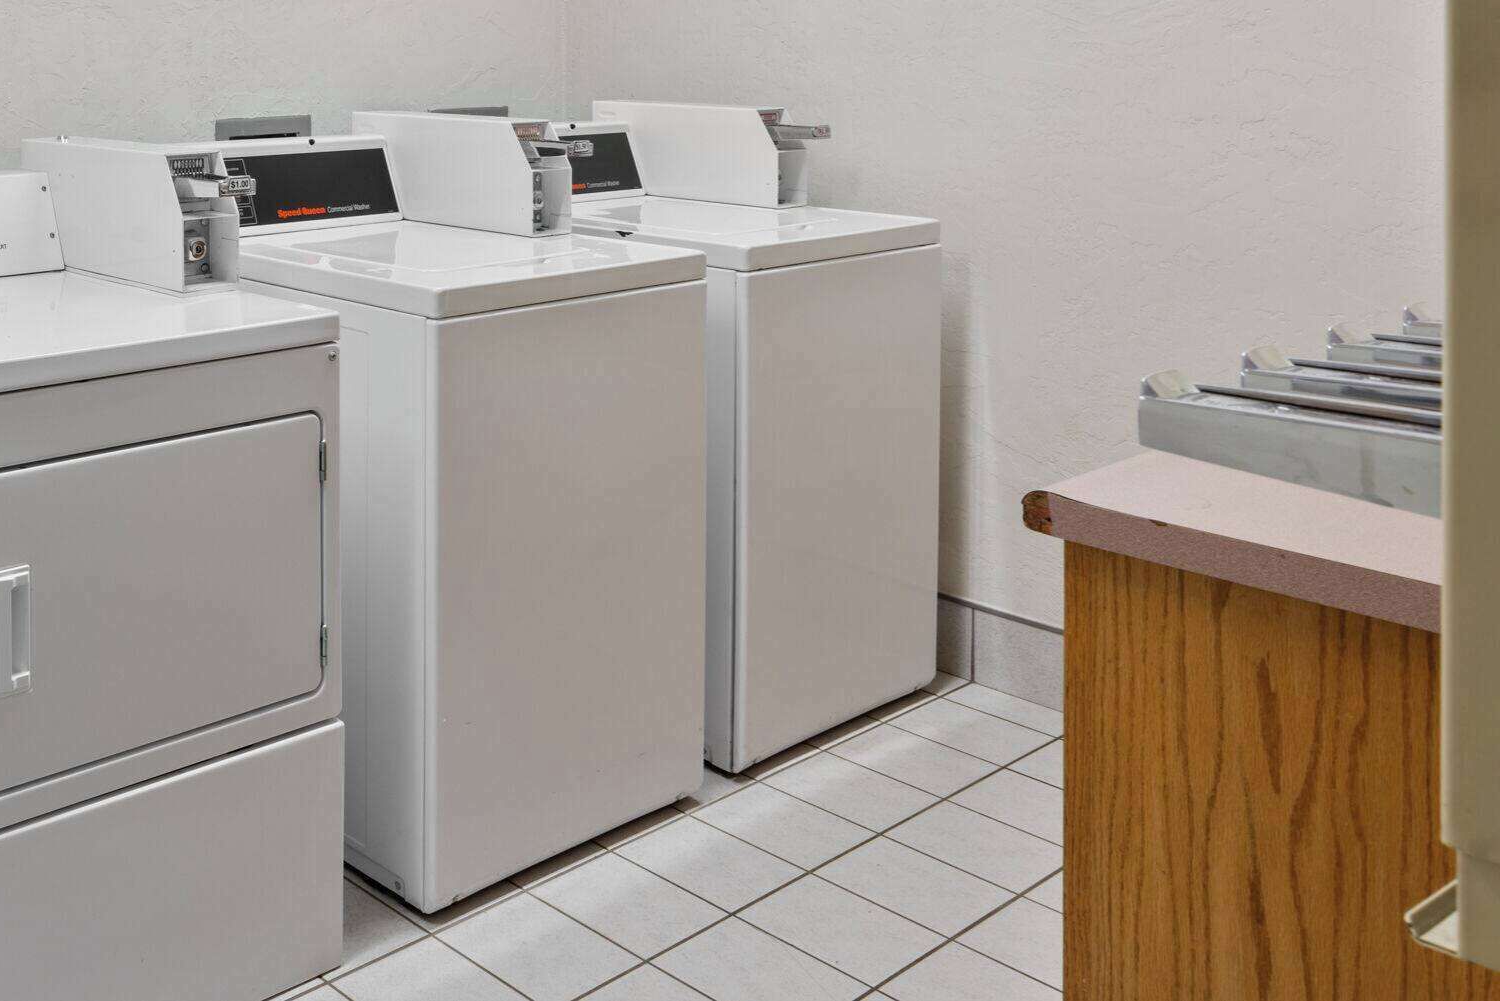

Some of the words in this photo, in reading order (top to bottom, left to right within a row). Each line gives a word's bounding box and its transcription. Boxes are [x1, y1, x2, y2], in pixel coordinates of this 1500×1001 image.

[230, 180, 249, 189] $1.00
[277, 208, 301, 220] Speed
[301, 206, 327, 216] Queen
[327, 205, 353, 214] Commercial
[353, 203, 371, 211] Washer
